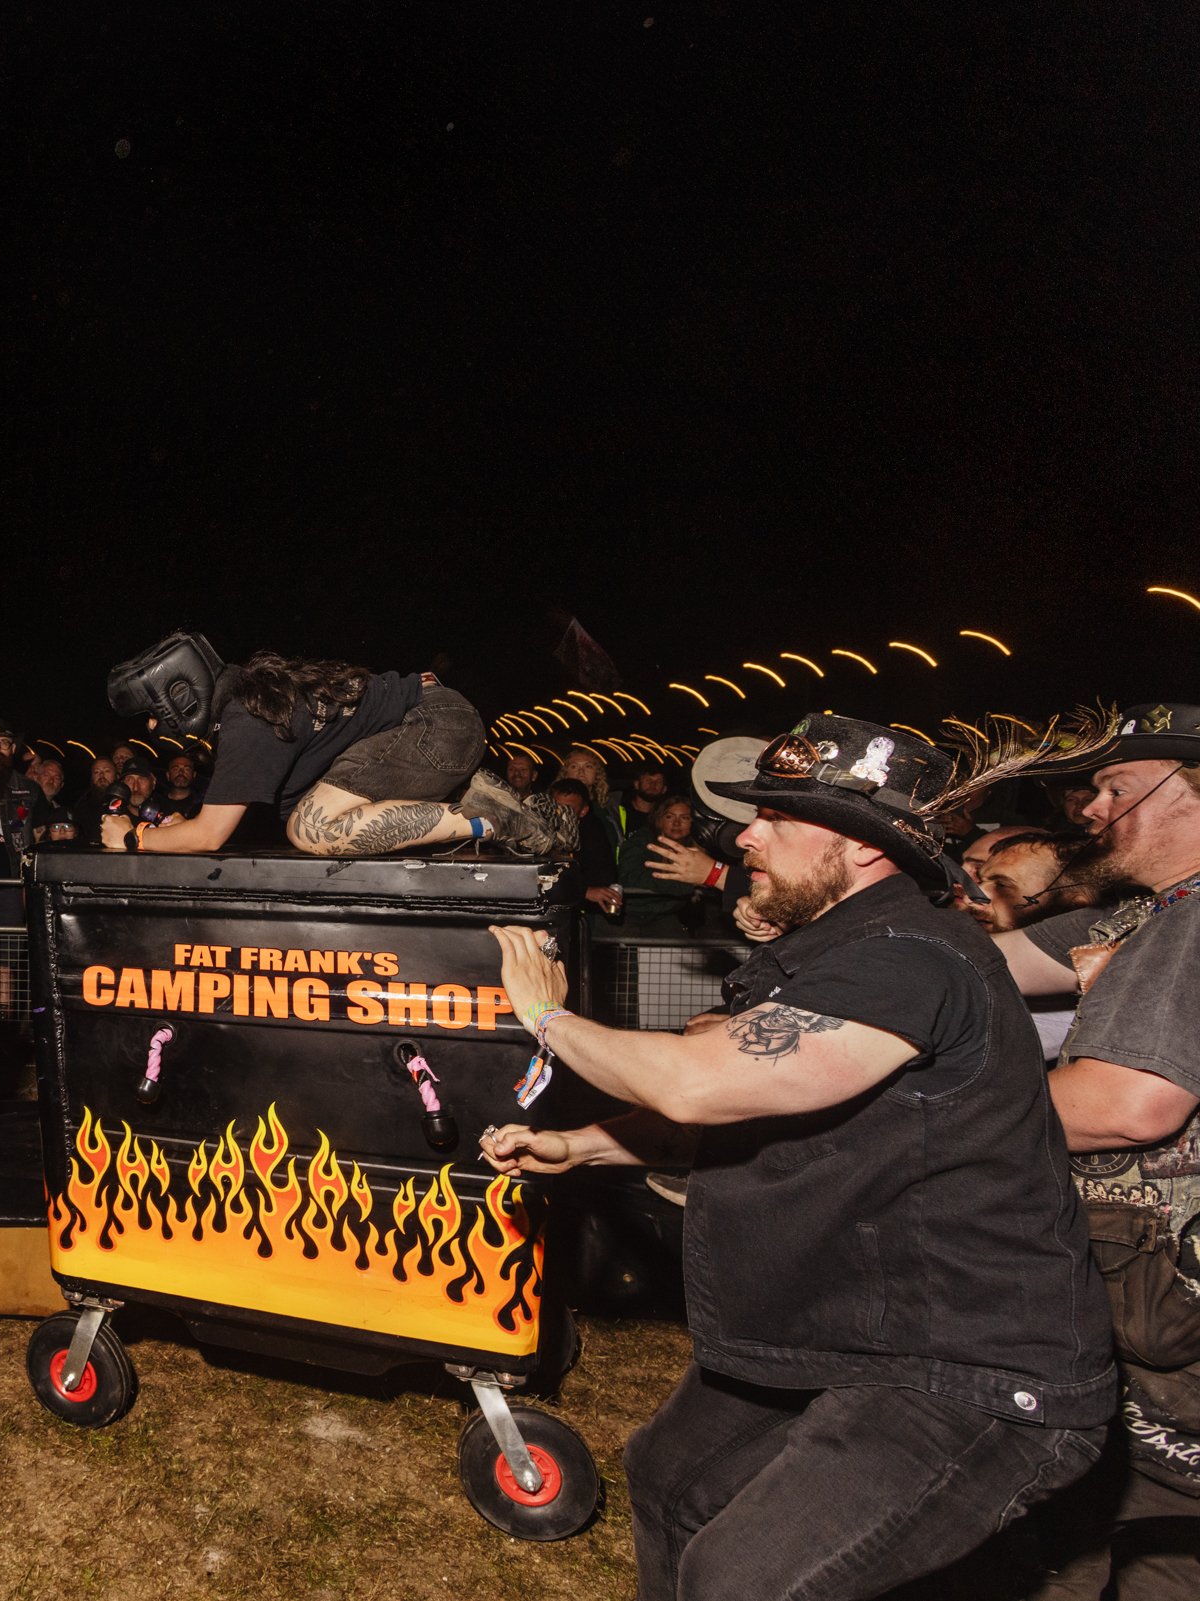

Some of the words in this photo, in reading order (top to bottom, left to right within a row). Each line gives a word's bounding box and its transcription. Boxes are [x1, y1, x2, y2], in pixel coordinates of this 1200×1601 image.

[174, 943, 232, 969] FAT
[240, 946, 400, 977] FRANK'S
[82, 965, 331, 1023] CAMPING
[346, 979, 516, 1032] SHOP
